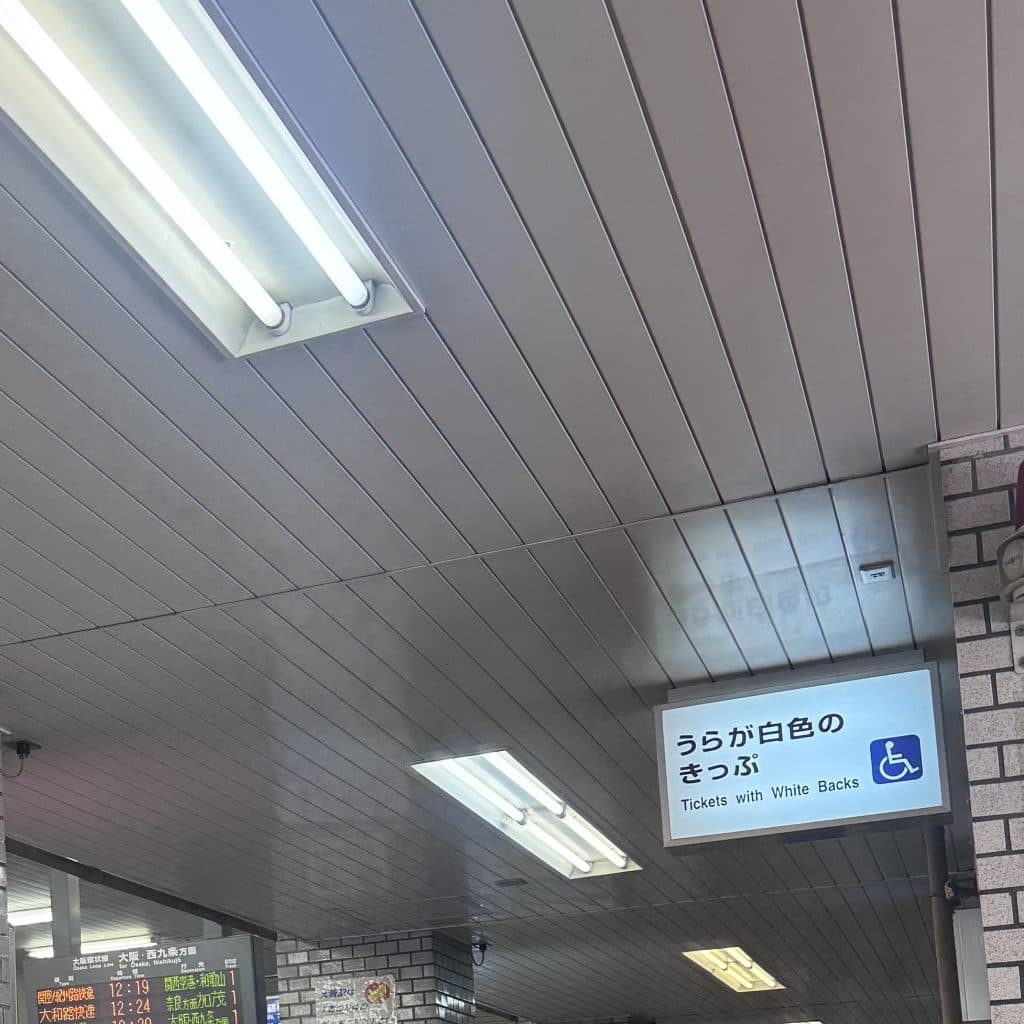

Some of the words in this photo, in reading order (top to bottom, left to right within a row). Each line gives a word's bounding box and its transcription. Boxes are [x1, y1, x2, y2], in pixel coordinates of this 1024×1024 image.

[676, 713, 845, 756] うらが白色の
[679, 753, 760, 784] きっぷ
[681, 794, 728, 811] Tickets
[736, 789, 763, 804] with
[771, 783, 810, 800] White
[818, 776, 860, 793] Backs
[118, 946, 197, 963] 大阪・西九条方面
[109, 979, 149, 997] 12:19
[229, 970, 235, 986] 1
[39, 1004, 95, 1023] 大和路快速
[111, 998, 151, 1016] 12:24
[231, 990, 237, 1005] 1
[232, 1009, 238, 1024] 1
